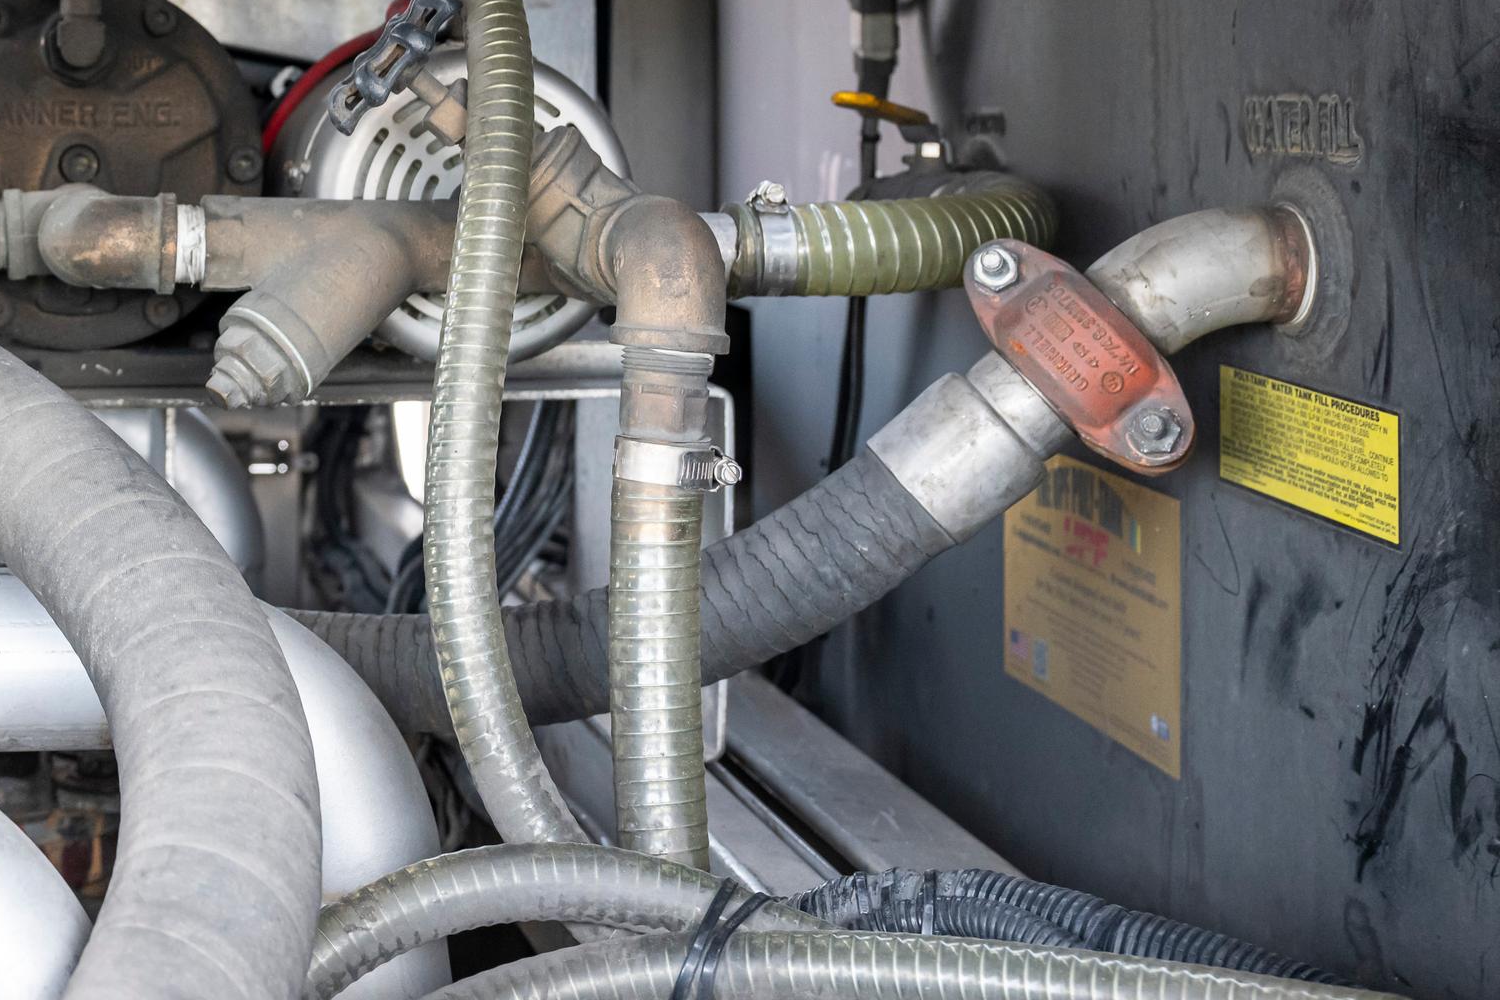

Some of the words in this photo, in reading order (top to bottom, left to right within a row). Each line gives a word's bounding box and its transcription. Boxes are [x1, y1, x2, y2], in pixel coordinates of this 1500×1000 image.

[112, 100, 181, 128] ENG.
[1244, 95, 1315, 156] WATER
[1316, 95, 1365, 166] FILL
[1025, 323, 1089, 392] GRINNELL
[1271, 381, 1293, 395] WATER
[1295, 388, 1313, 402] TANK
[1314, 394, 1329, 408] FILL
[1331, 399, 1380, 422] PROCEDURES
